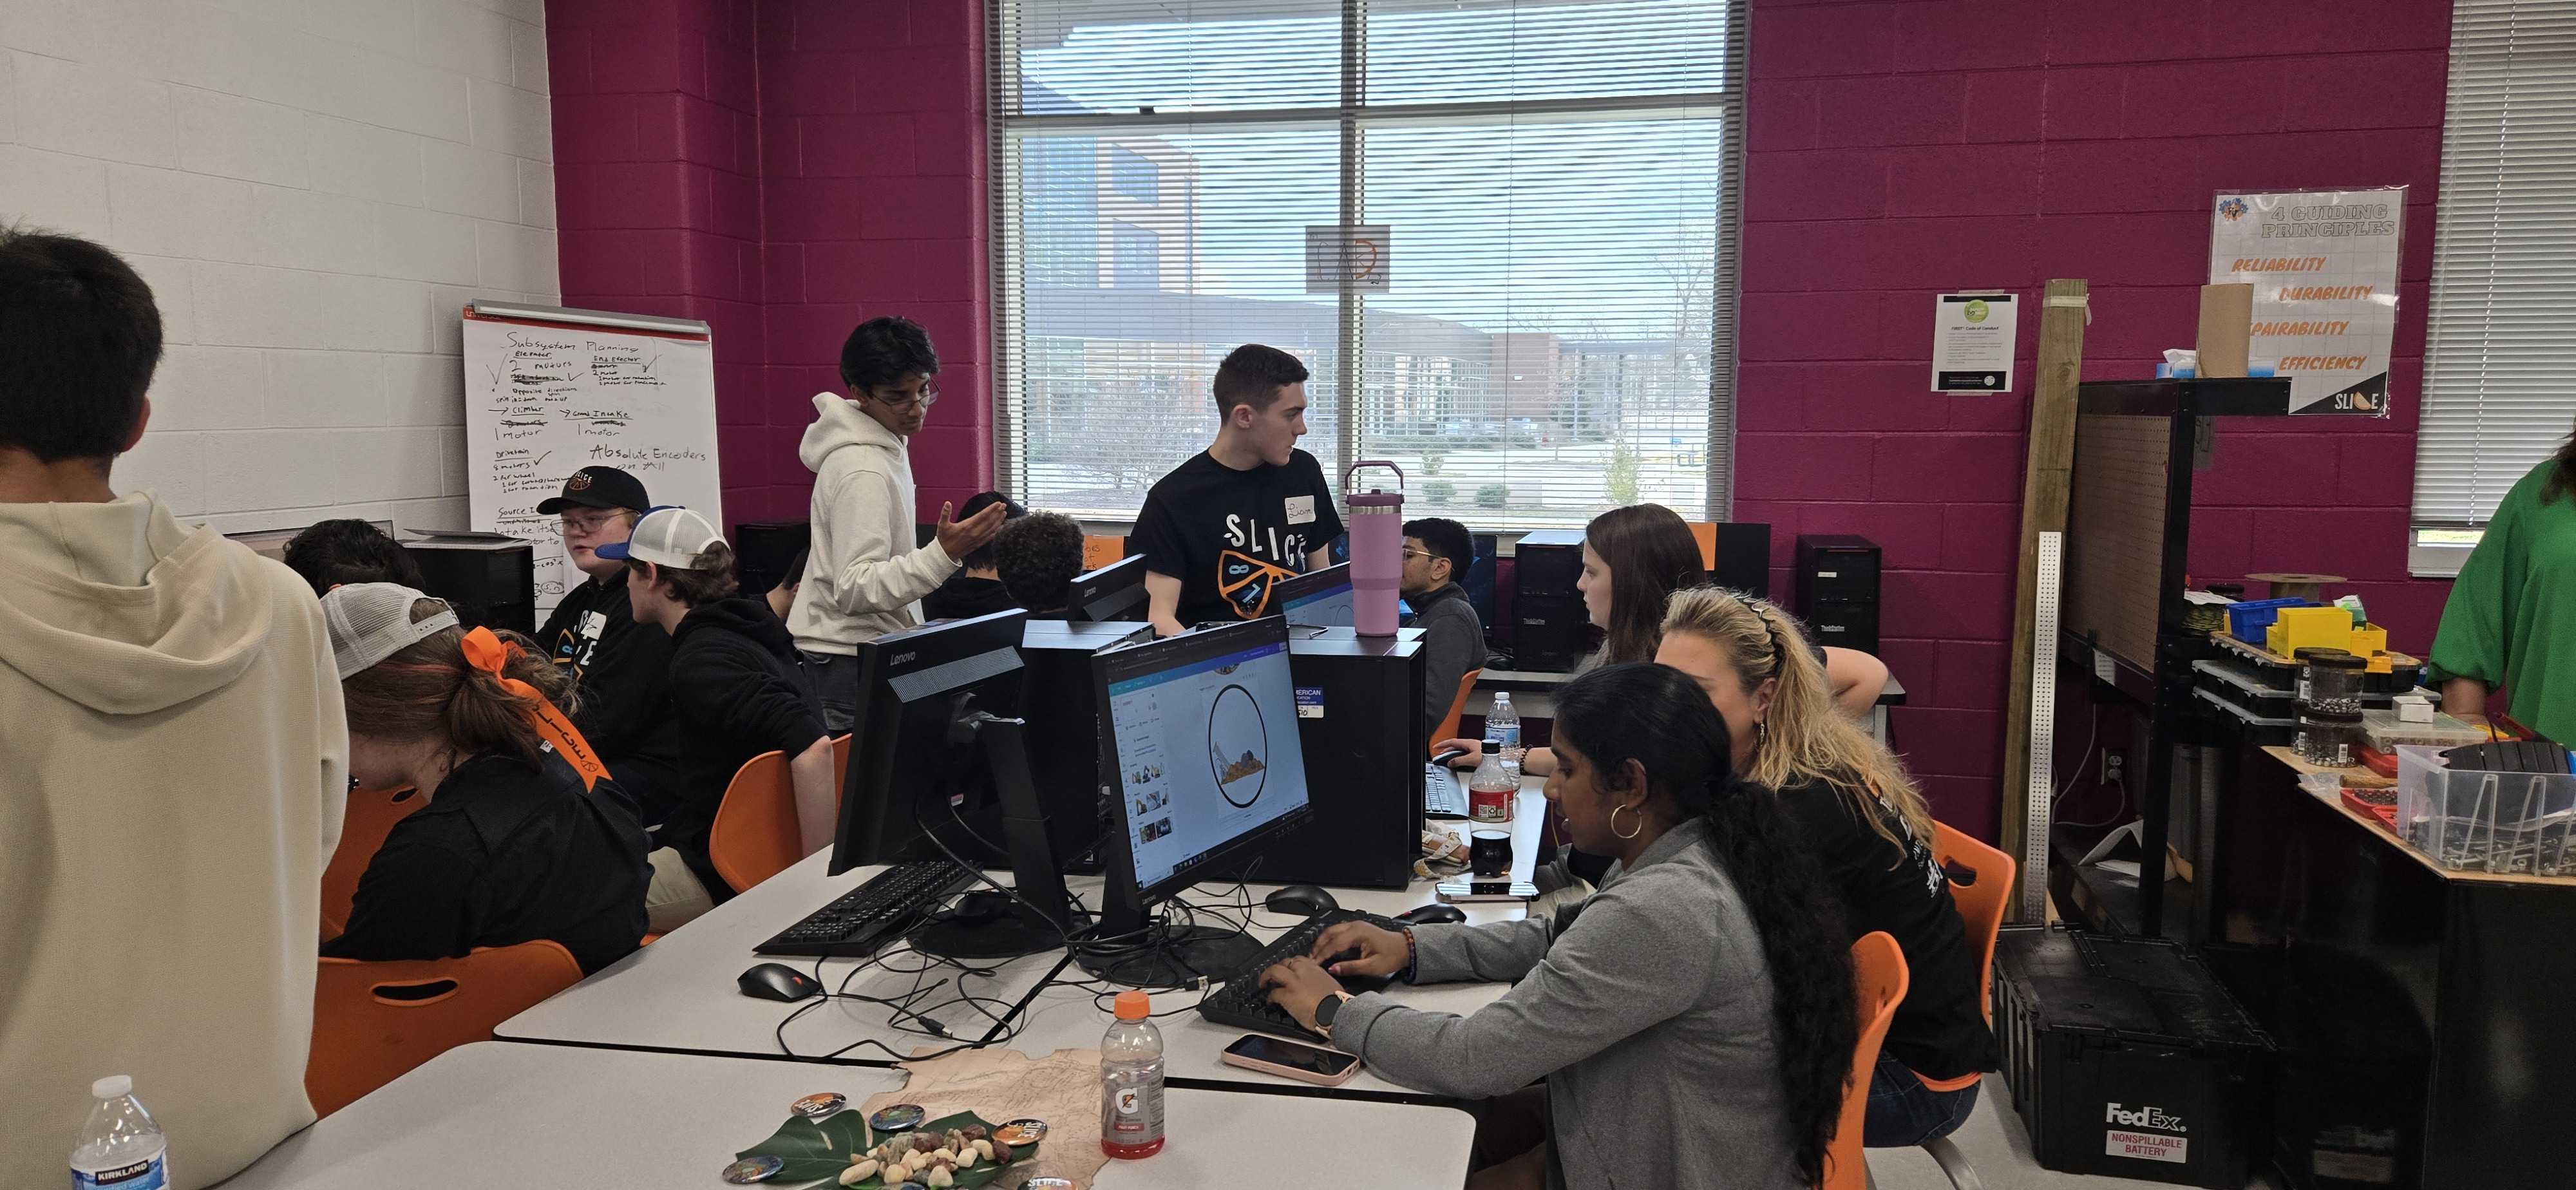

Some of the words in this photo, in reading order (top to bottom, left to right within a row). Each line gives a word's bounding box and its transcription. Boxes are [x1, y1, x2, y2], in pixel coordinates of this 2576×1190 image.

[2272, 207, 2284, 221] 4
[2291, 204, 2388, 221] GUIDING
[2262, 221, 2395, 238] PRINCIPLES
[2231, 256, 2327, 272] RELIABILITY
[2278, 285, 2373, 301] DURABILITY
[2250, 321, 2350, 337] PAIRABILITY
[2278, 356, 2367, 371] EFFICIENCY
[589, 444, 648, 460] Absolute
[653, 446, 706, 461] Encoders
[498, 507, 526, 517] Source
[890, 651, 916, 666] Lenovo
[2106, 1102, 2182, 1131] FedEx
[2112, 1133, 2183, 1148] NONSPILLABLE
[2125, 1144, 2167, 1157] BATTERY
[98, 1162, 147, 1181] KIRKLAND
